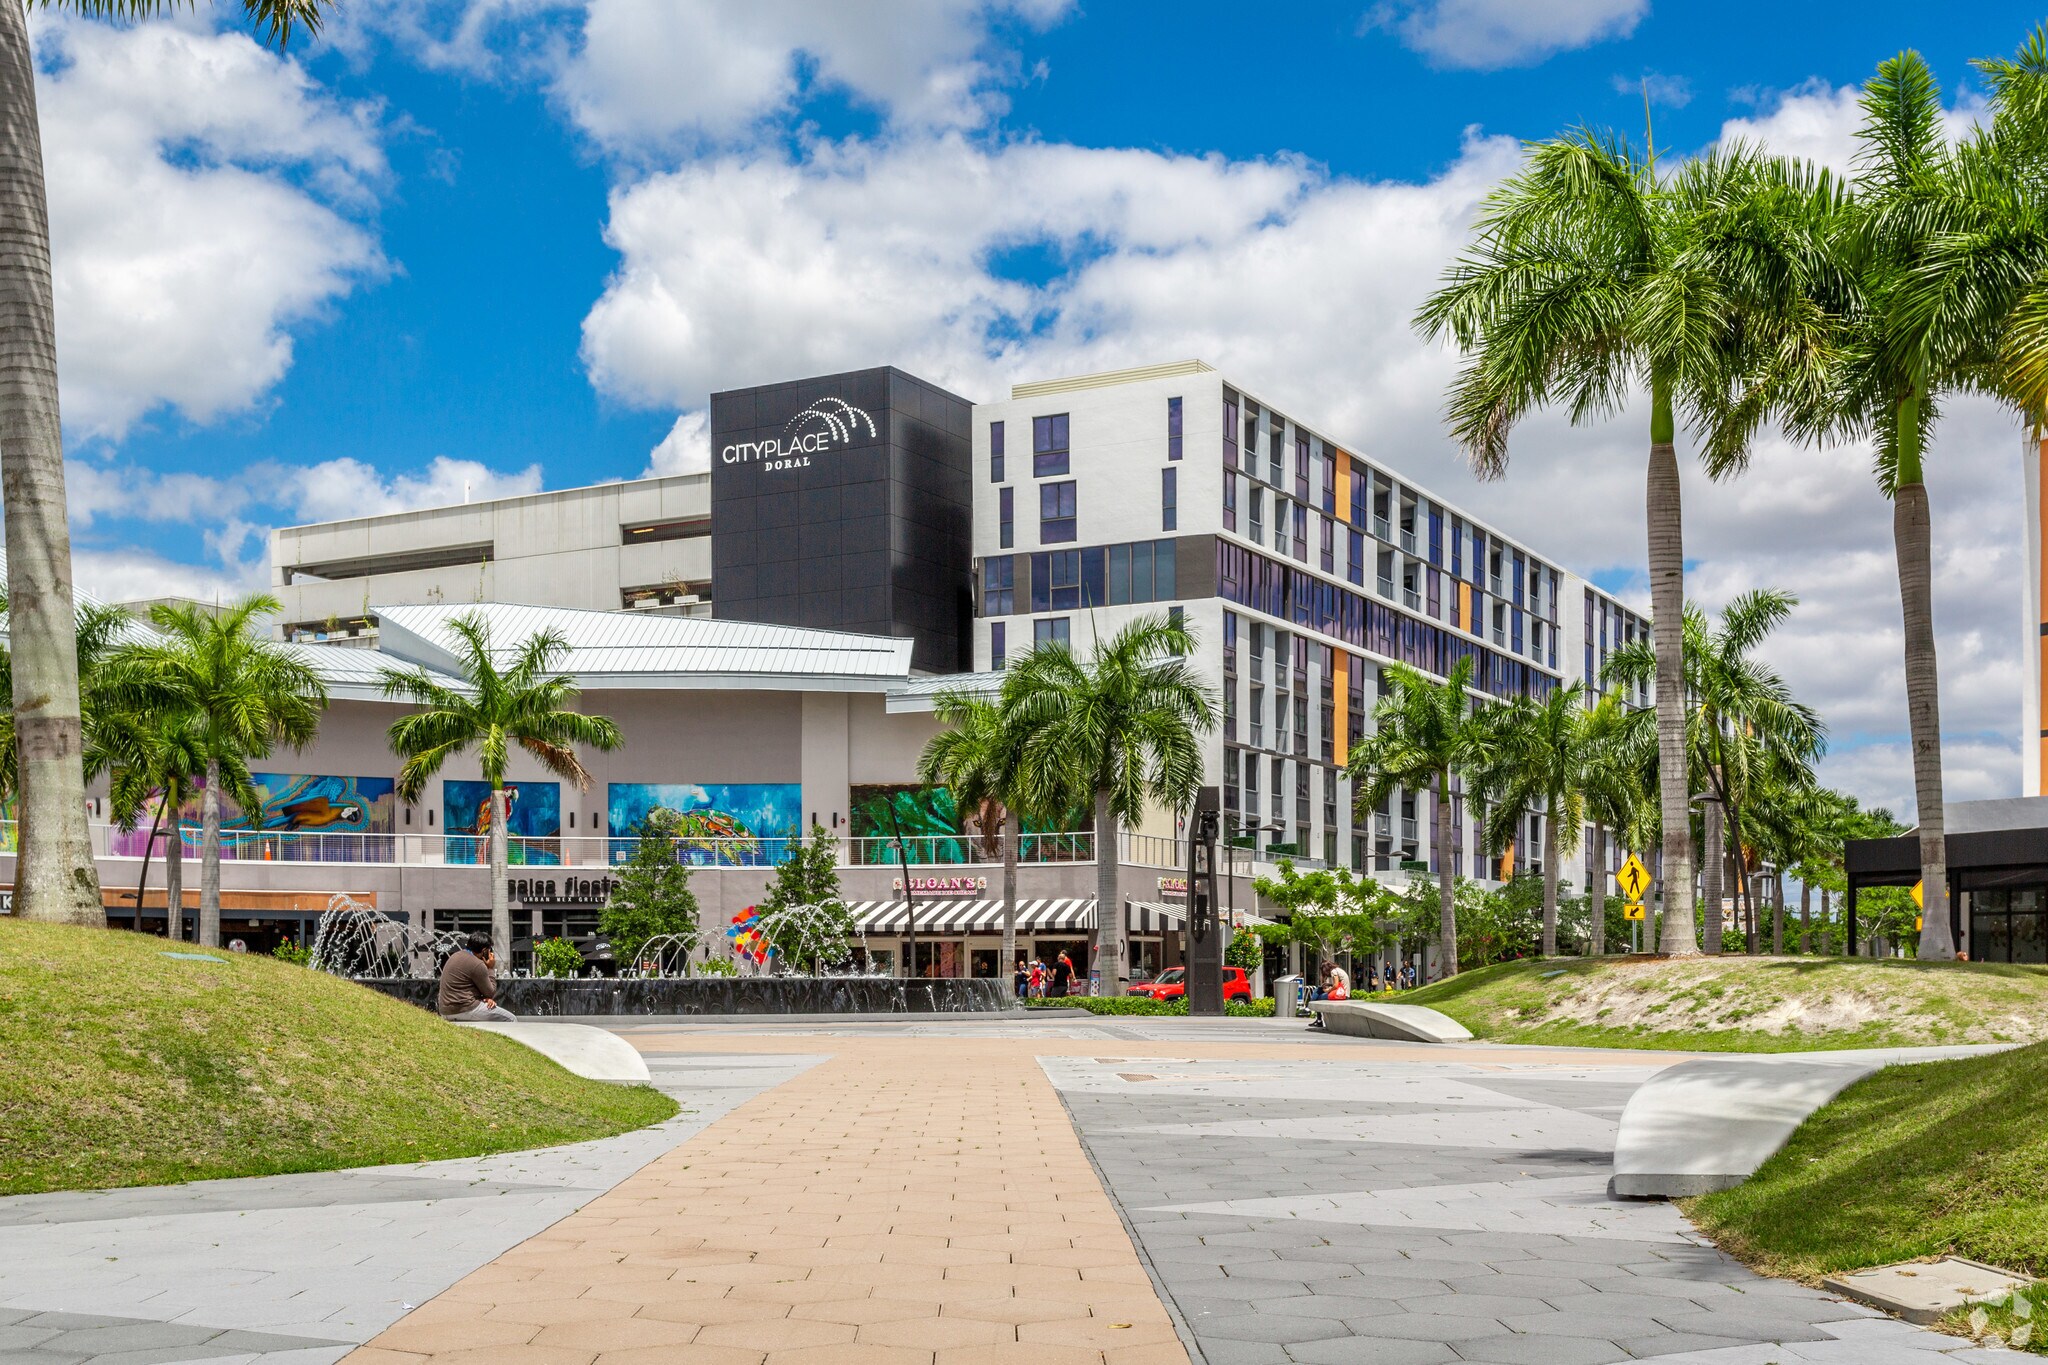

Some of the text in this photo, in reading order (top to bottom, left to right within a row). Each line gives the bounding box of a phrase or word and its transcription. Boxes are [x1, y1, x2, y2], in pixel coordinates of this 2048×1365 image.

[722, 432, 829, 463] CITYPLACE
[765, 457, 811, 471] DORAL
[508, 878, 556, 894] salsa
